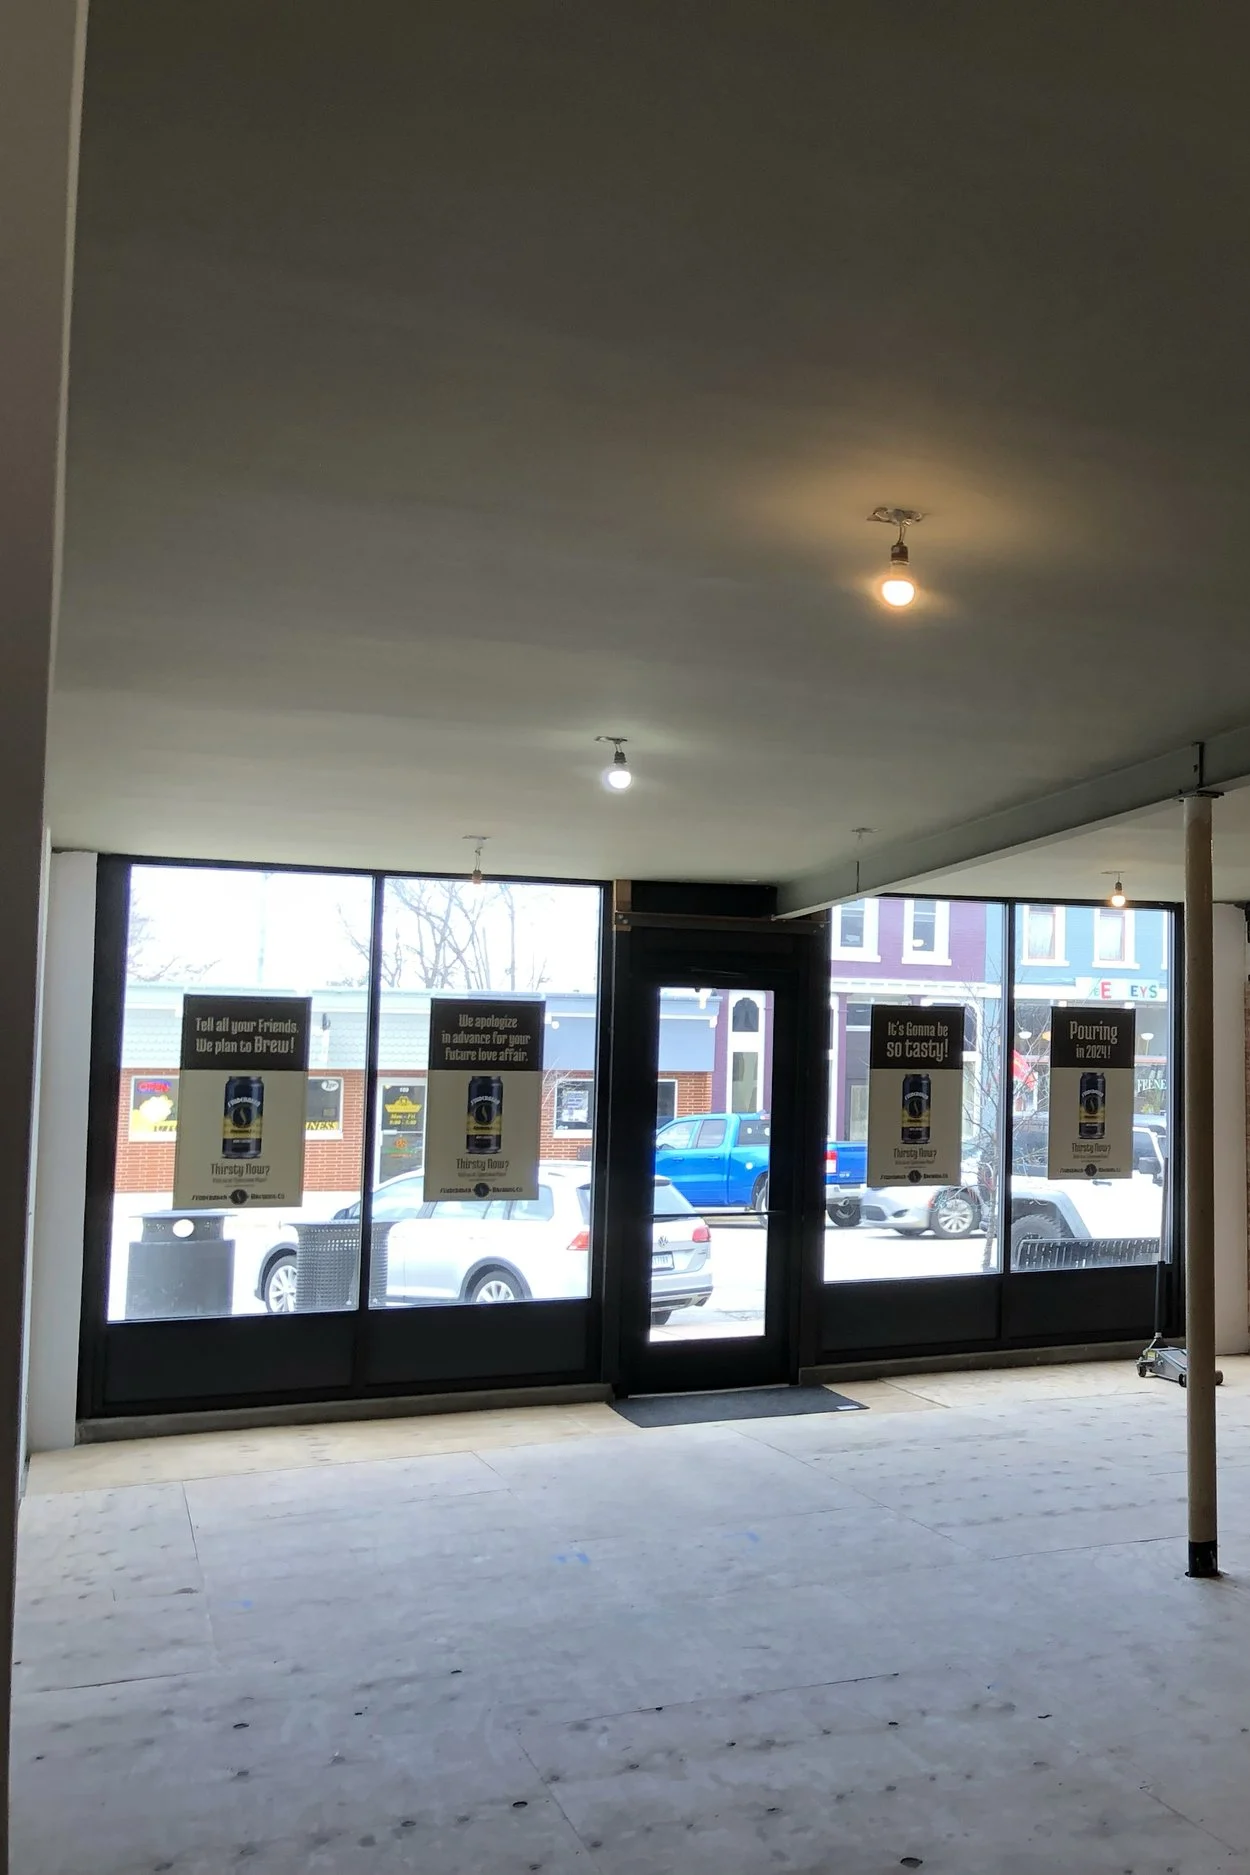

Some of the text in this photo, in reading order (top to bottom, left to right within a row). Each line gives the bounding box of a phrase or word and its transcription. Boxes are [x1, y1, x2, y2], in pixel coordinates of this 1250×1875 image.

[196, 1017, 299, 1035] Tell all your Friends.
[459, 1014, 518, 1030] We apologize
[888, 1021, 949, 1037] It's Gonna be
[441, 1030, 531, 1047] in advance for your
[1069, 1020, 1118, 1045] Pouring
[196, 1036, 295, 1055] We plan to Brew!
[886, 1039, 948, 1062] so tasty!
[1076, 1044, 1111, 1059] in 2024!
[445, 1047, 528, 1062] future love affair.
[210, 1163, 270, 1177] Thirsty Now?
[456, 1159, 509, 1171] Thirsty Now?
